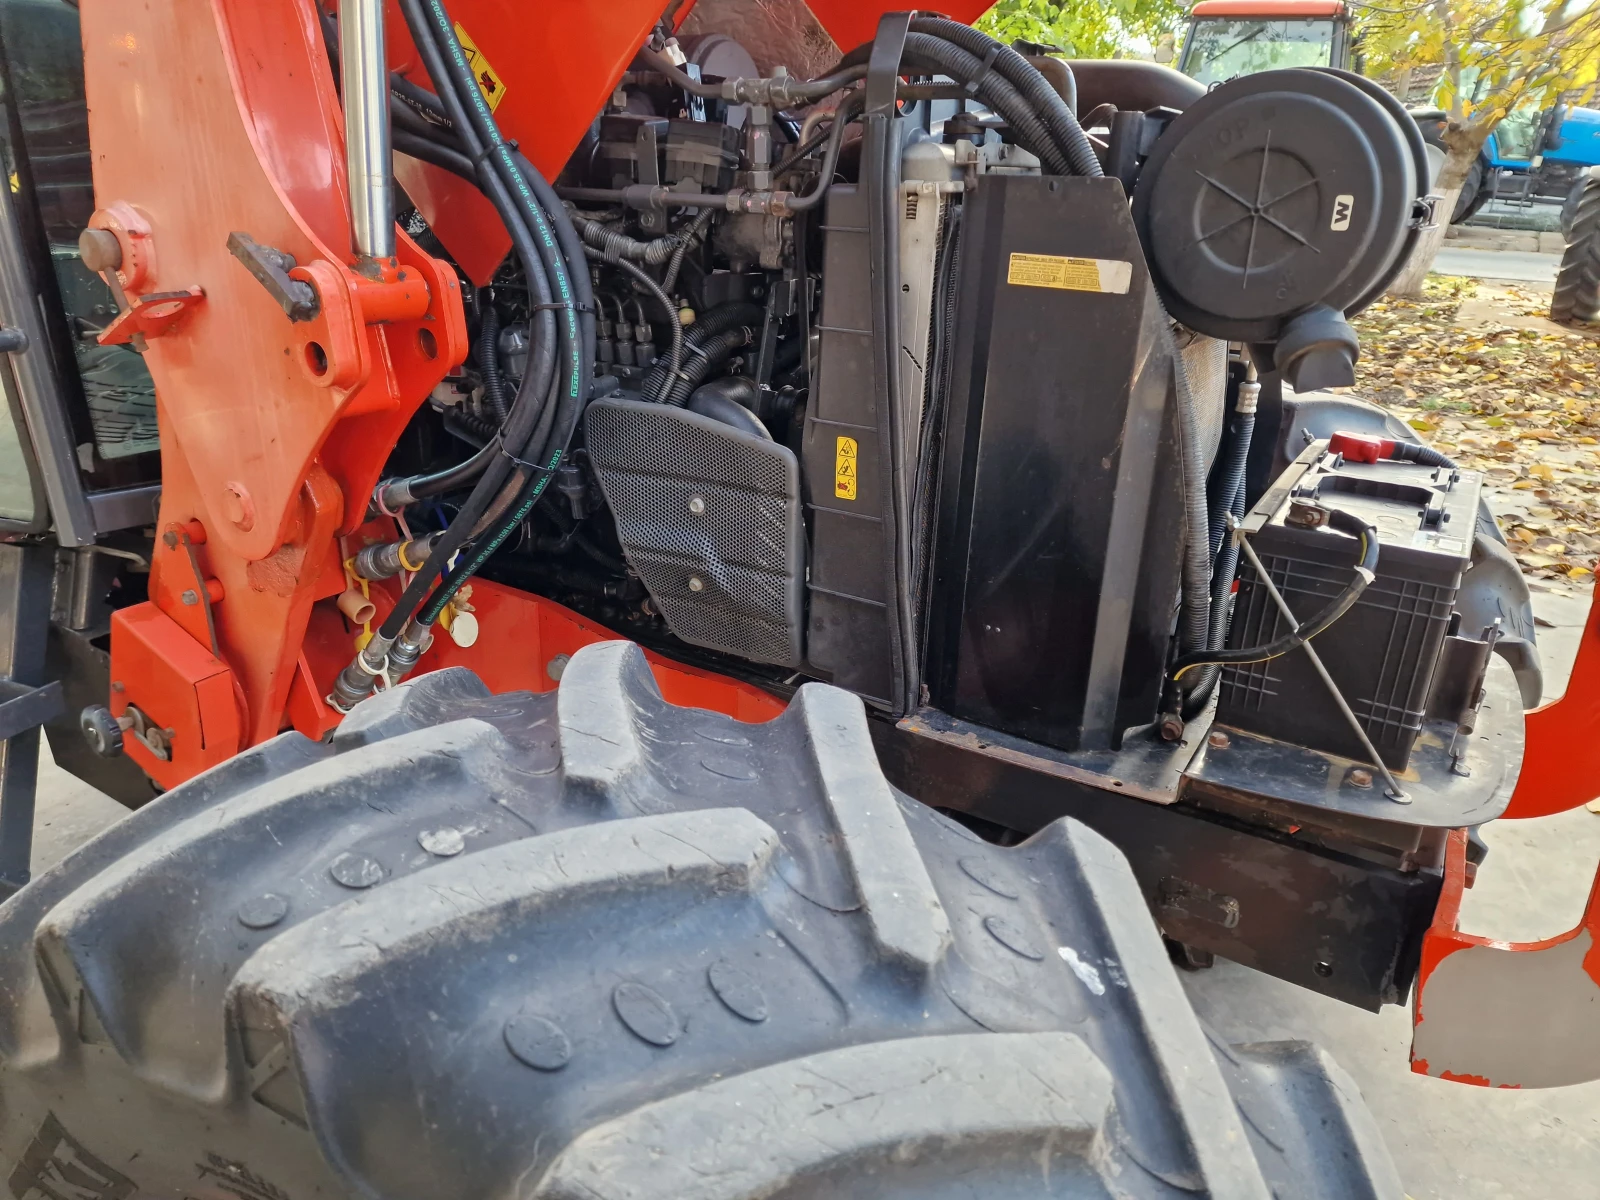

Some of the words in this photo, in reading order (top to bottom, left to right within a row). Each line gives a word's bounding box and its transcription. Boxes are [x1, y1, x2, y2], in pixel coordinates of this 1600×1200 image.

[448, 38, 464, 67] MSHA
[464, 77, 476, 91] psi
[471, 91, 486, 113] 5076
[484, 117, 495, 131] bar
[490, 132, 501, 145] 50
[501, 149, 514, 167] MPa
[509, 167, 523, 184] 35.0
[519, 184, 530, 198] WP
[539, 225, 554, 248] DN12
[556, 271, 570, 299] EN857
[505, 521, 515, 531] bar
[532, 477, 547, 495] MSHA
[547, 449, 562, 474] Q/2023
